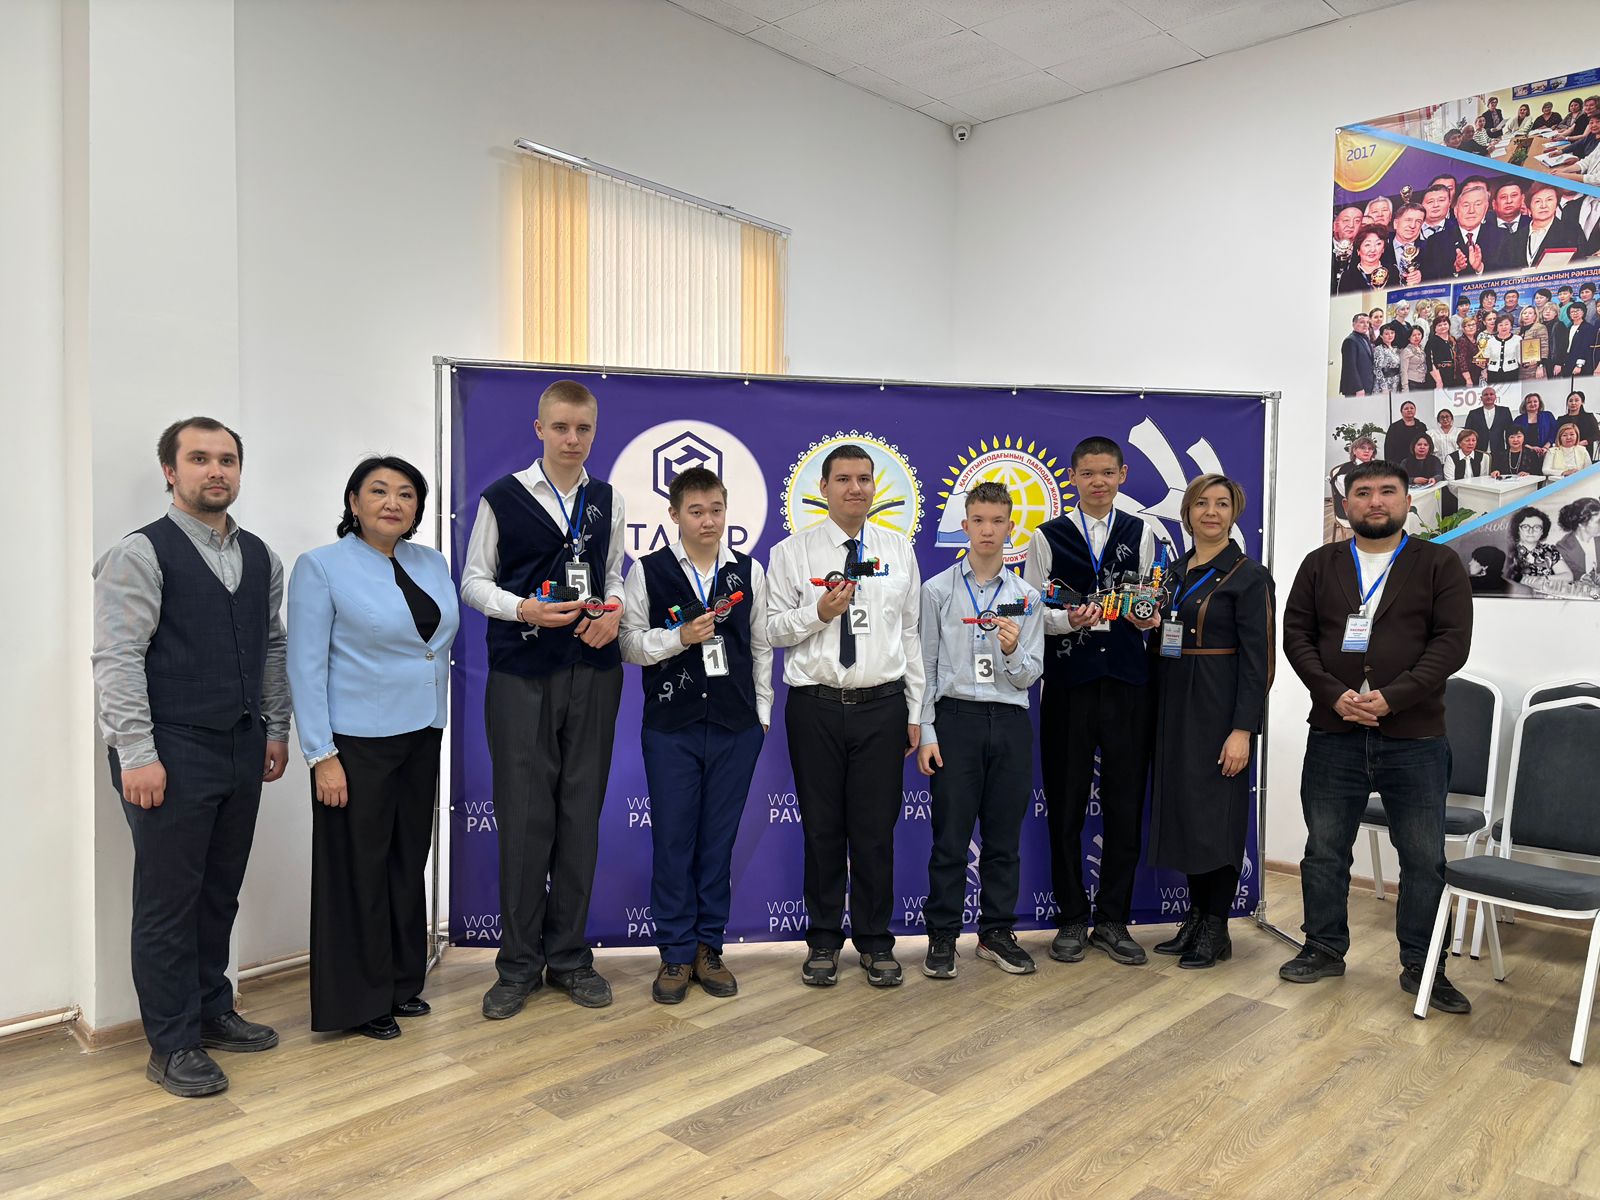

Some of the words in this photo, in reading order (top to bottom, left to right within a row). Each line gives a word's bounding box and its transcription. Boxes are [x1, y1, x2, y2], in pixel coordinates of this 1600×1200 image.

[1346, 144, 1377, 162] 2017
[1462, 281, 1500, 291] ҚАЗАҚСТАН
[1500, 273, 1570, 286] РЕСПУБЛИКАСЫНЫҢ
[1453, 390, 1477, 407] 50
[1026, 458, 1054, 486] ПАВЛОДАР
[1049, 486, 1061, 517] ЖОҒАРЫ
[570, 574, 586, 595] 5
[852, 609, 868, 628] 2
[707, 649, 720, 669] 1
[978, 658, 993, 677] 3
